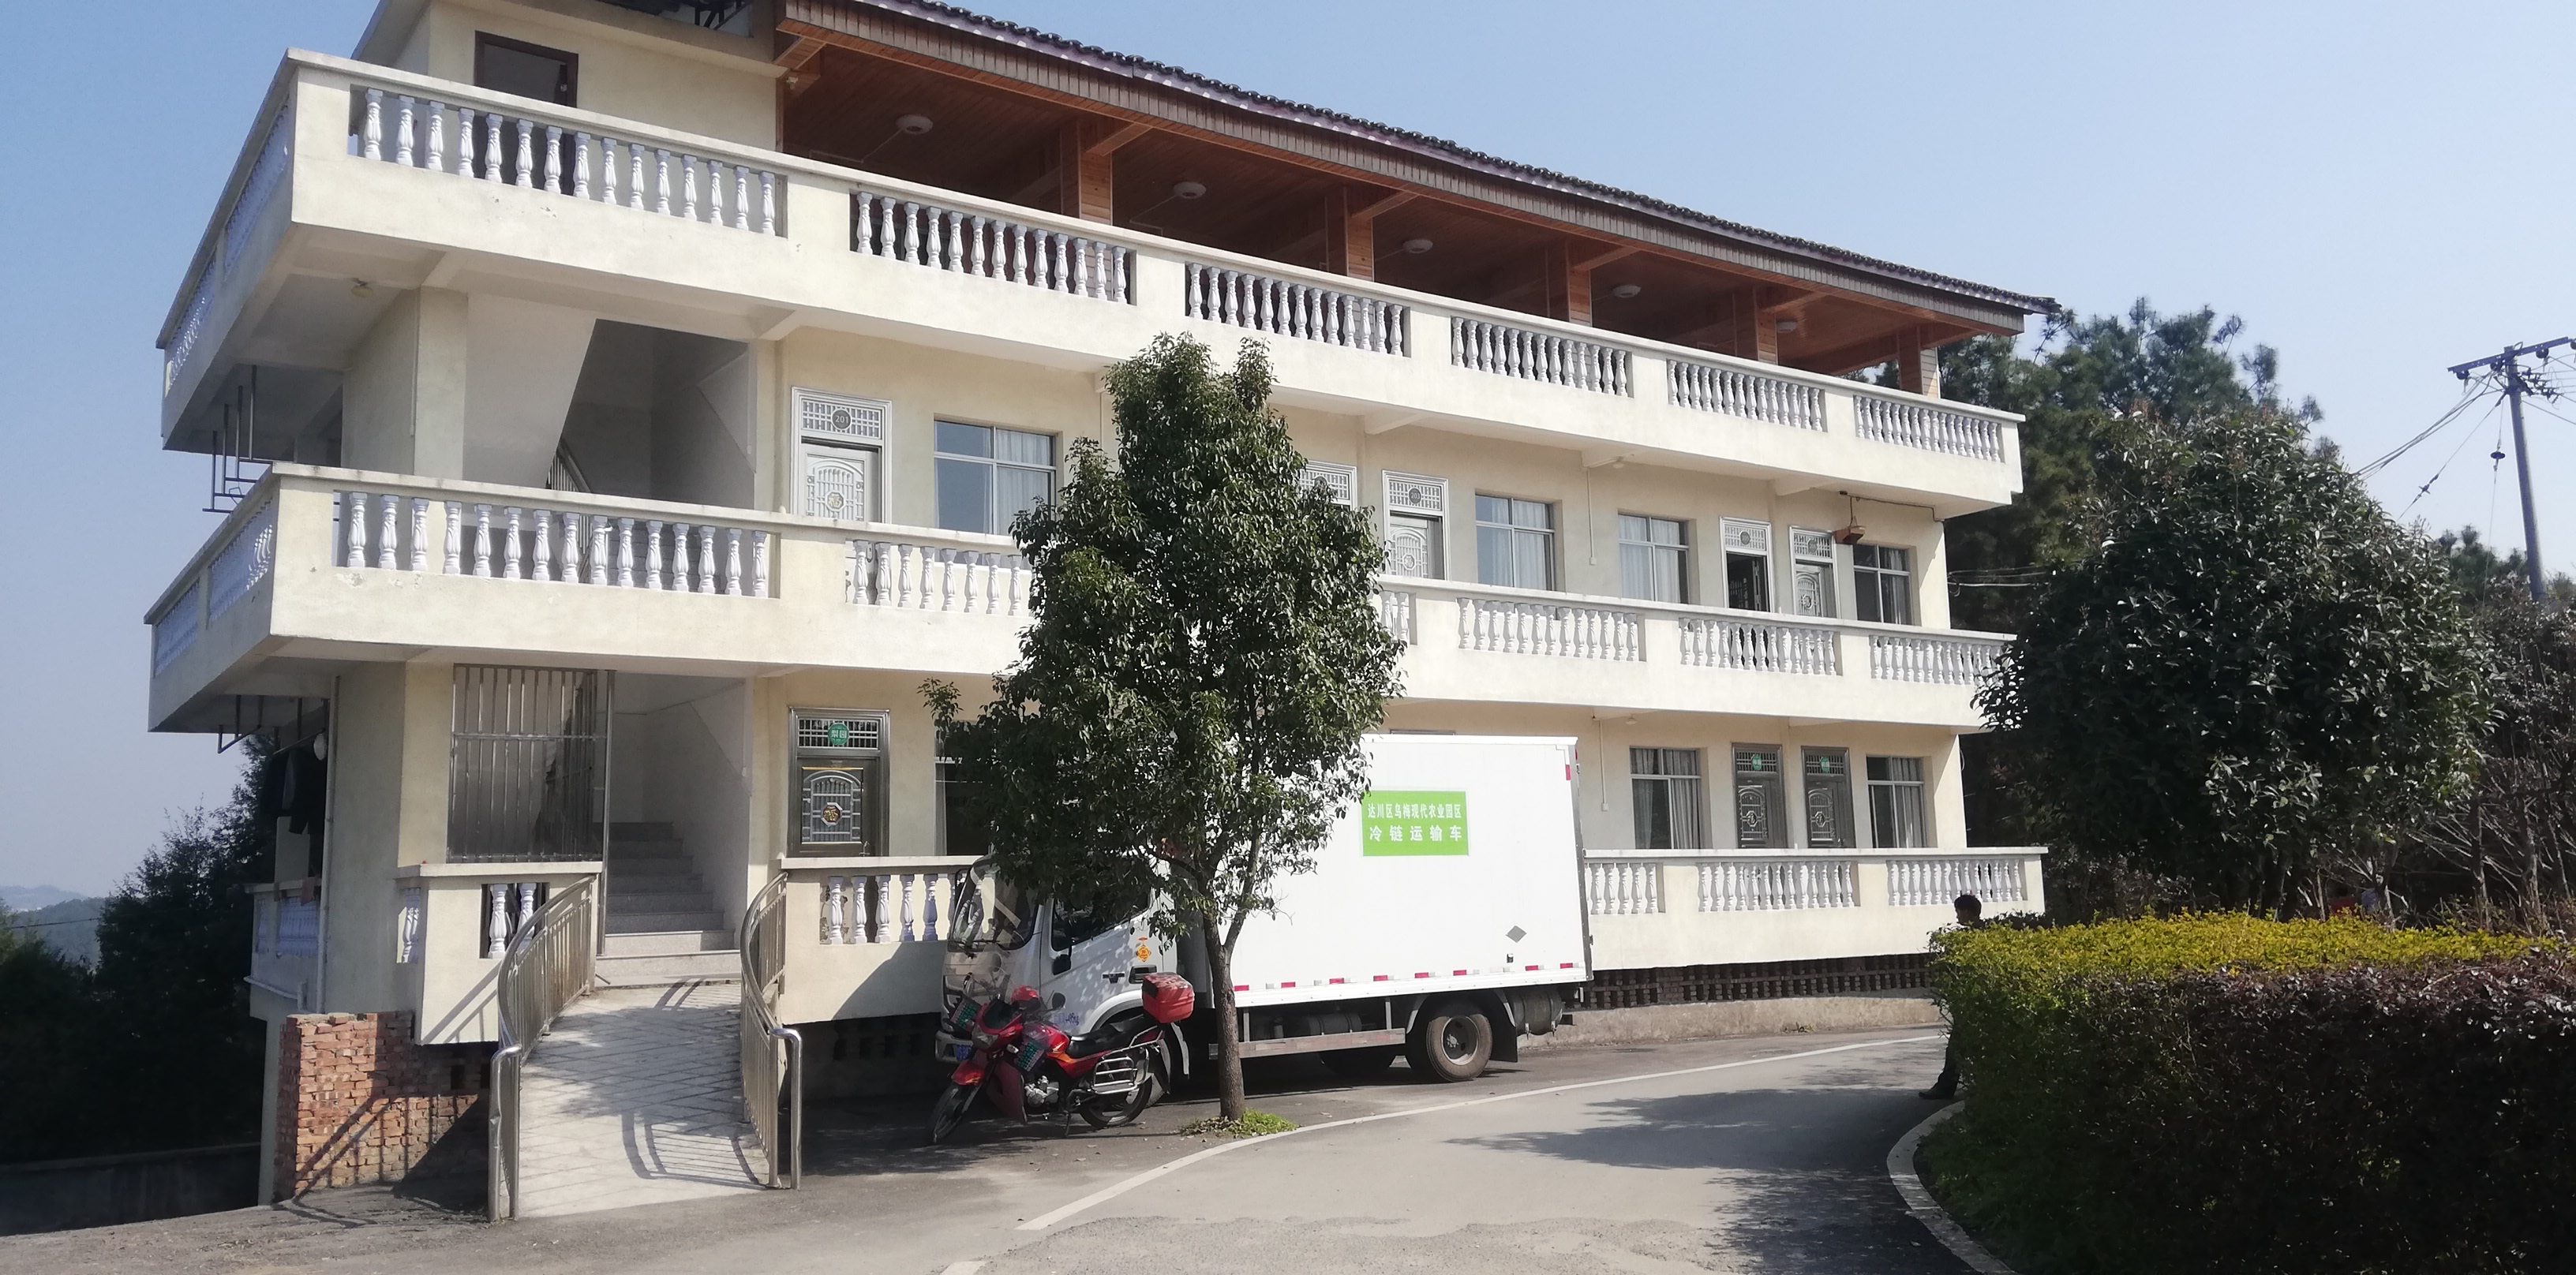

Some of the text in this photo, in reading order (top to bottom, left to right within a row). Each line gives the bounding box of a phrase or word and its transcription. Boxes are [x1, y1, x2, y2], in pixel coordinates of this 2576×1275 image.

[835, 415, 848, 424] 201
[1368, 803, 1462, 819] 达川区乌梅现代农业园区
[1369, 824, 1462, 842] 冷链运输车
